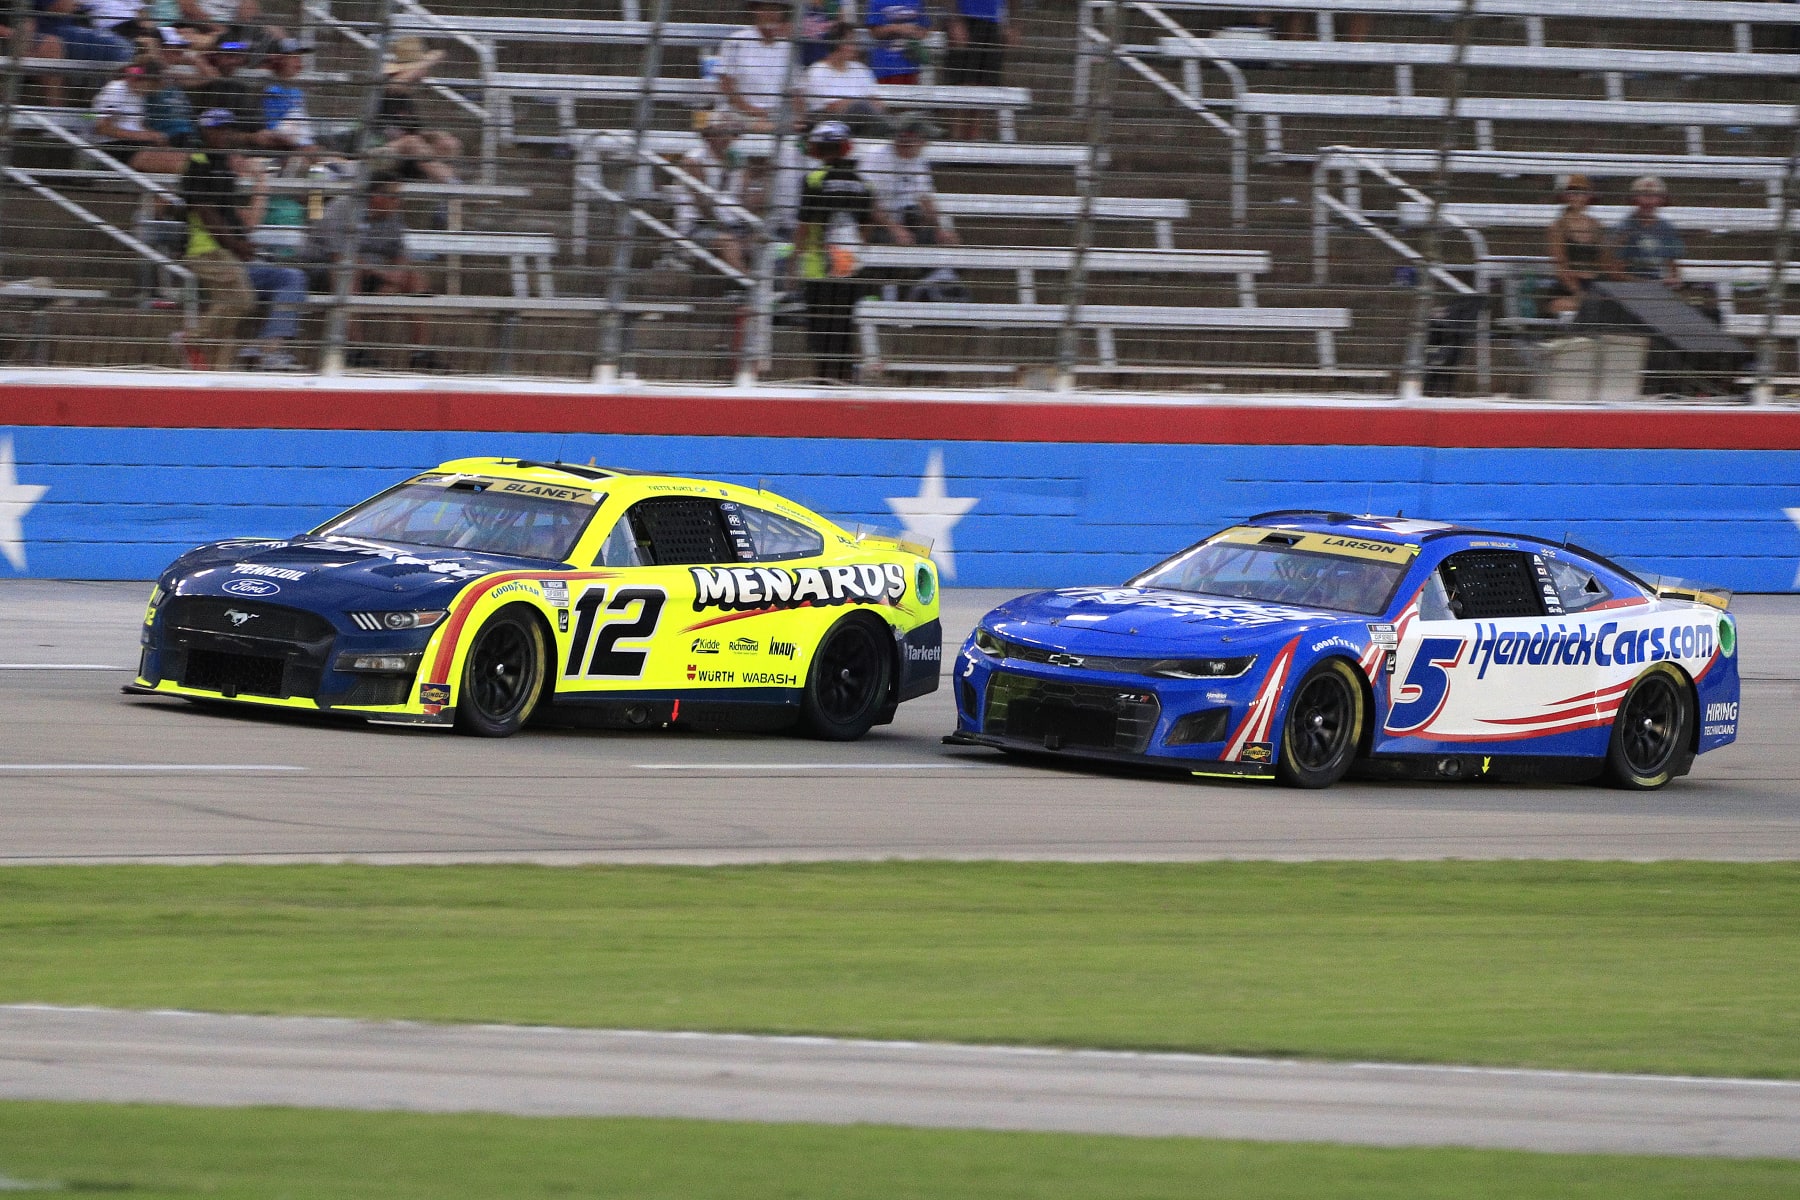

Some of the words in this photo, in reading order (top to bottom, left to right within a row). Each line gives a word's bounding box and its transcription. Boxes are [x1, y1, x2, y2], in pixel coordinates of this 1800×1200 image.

[504, 484, 584, 500] BLANEY
[1322, 537, 1396, 554] LARSON
[230, 562, 306, 581] PENNZOIL
[231, 580, 270, 594] Ford
[491, 581, 540, 599] GOODYEAR
[689, 563, 906, 612] MENARDS
[564, 587, 667, 679] 12
[700, 639, 721, 650] Kidde
[729, 641, 759, 652] Richmond
[1312, 636, 1360, 653] GOODYEAR
[1469, 622, 1713, 679] HendrickCars.com
[908, 645, 941, 661] Tarkett
[699, 670, 735, 683] WÜRTH
[742, 672, 797, 685] WABASH
[1384, 635, 1466, 736] 5
[421, 691, 450, 699] SUNOCO
[1705, 702, 1738, 721] HIRING
[1703, 725, 1735, 736] TECHNICIANS
[1243, 748, 1270, 756] SUNOCO
